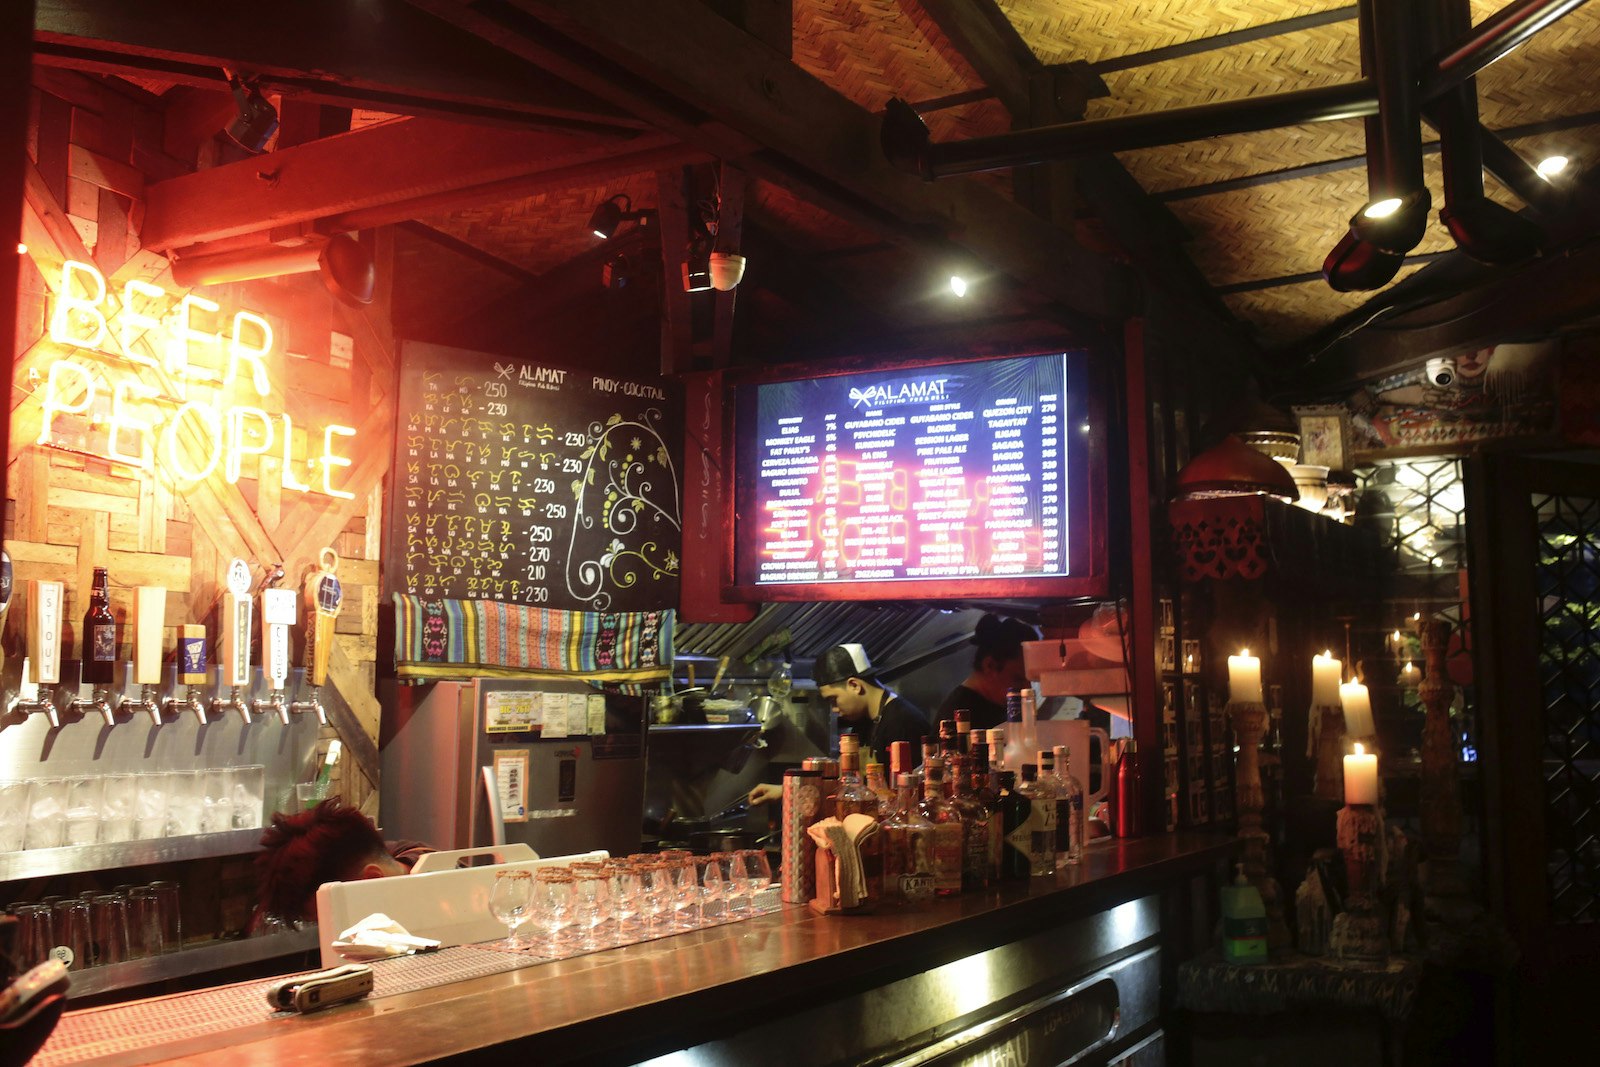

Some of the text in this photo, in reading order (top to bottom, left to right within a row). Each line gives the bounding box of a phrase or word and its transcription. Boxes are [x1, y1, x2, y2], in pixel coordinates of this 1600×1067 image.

[50, 259, 274, 396] BEER
[519, 364, 568, 384] ALAMAT
[875, 379, 948, 400] ALAMAT
[1015, 405, 1033, 415] CITY
[37, 360, 357, 500] PEOPLE
[409, 475, 418, 484] SA
[430, 477, 439, 486] LA
[448, 479, 457, 487] BA
[45, 597, 53, 674] STOUT
